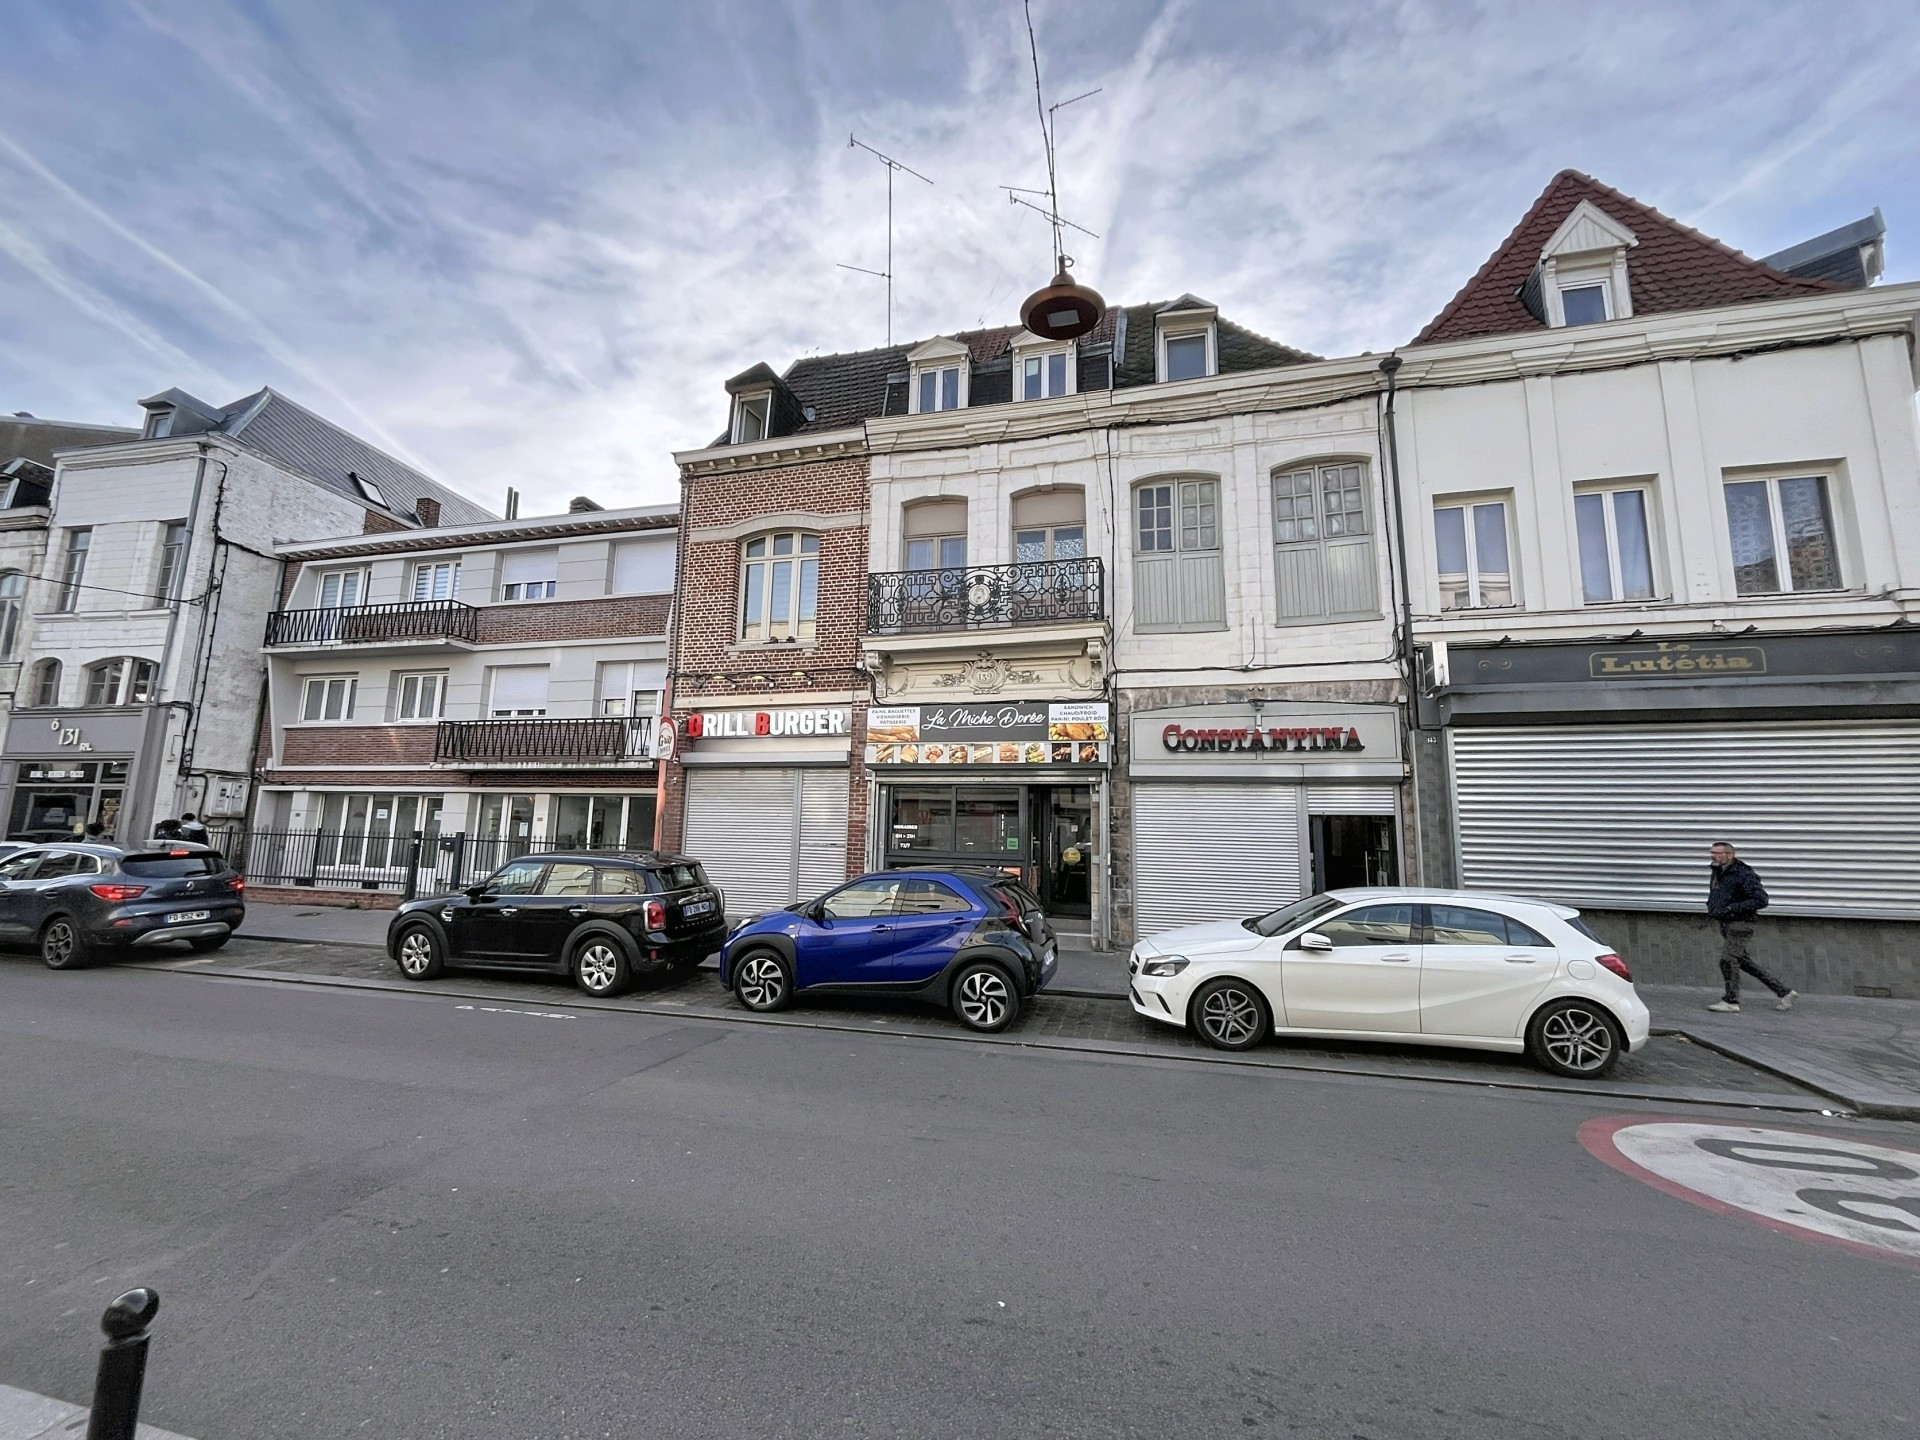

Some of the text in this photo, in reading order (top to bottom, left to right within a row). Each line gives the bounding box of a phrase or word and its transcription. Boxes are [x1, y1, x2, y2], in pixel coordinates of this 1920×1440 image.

[1656, 642, 1690, 652] Le
[1601, 654, 1753, 673] Lutétia
[979, 673, 992, 681] 139
[688, 709, 845, 737] GRILL BURGER
[921, 706, 1046, 730] La Miche Dorée
[58, 728, 80, 745] 131
[1162, 723, 1366, 751] CONSTANTINA
